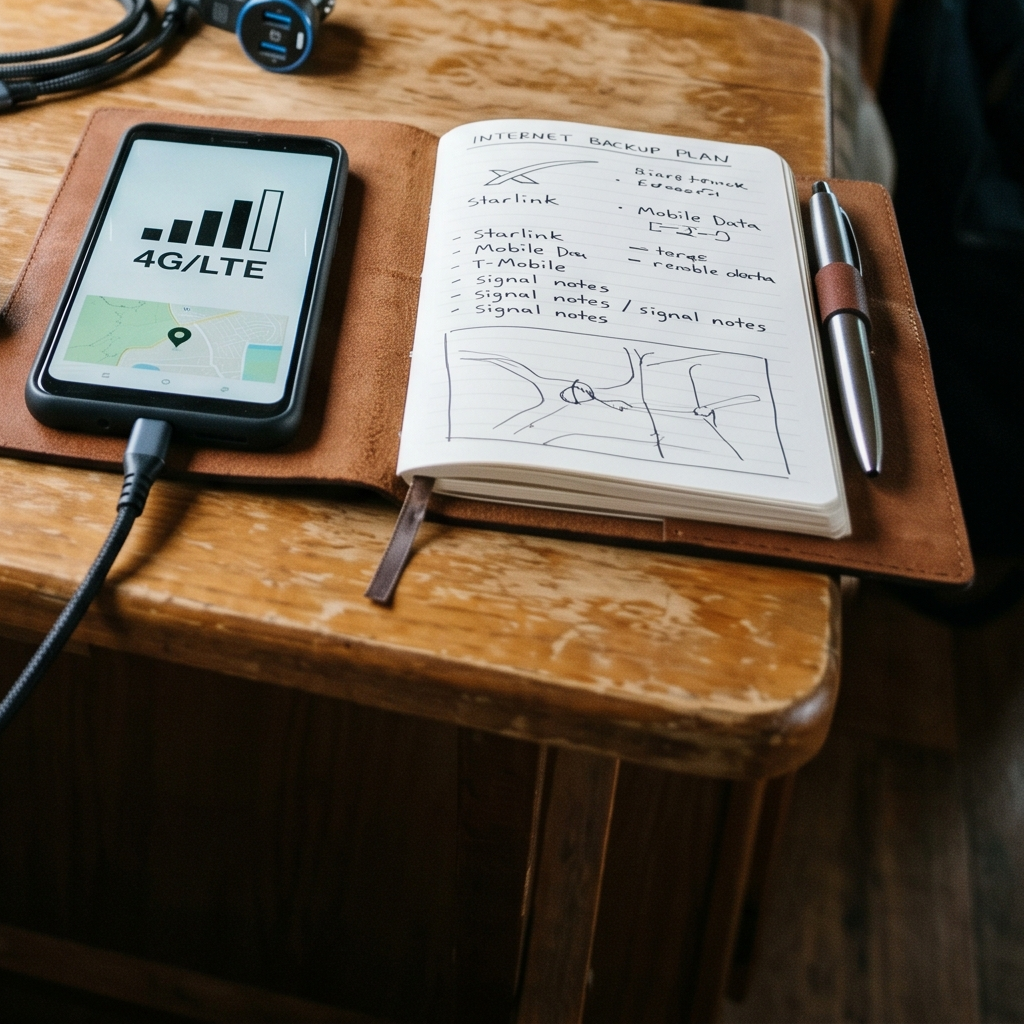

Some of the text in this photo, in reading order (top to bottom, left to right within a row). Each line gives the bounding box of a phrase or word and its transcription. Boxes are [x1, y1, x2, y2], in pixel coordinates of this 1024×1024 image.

[473, 132, 729, 163] INTERNET BACKUP PLAN
[638, 206, 762, 232] Mobile Data
[474, 228, 564, 241] Starlink
[475, 243, 544, 255] Mobile
[133, 249, 267, 280] 4G/LTE
[473, 258, 566, 272] T-Mobile
[554, 280, 610, 293] notes
[553, 295, 610, 309] notes
[640, 306, 699, 323] signal
[712, 318, 767, 333] notes
[555, 310, 608, 324] notes
